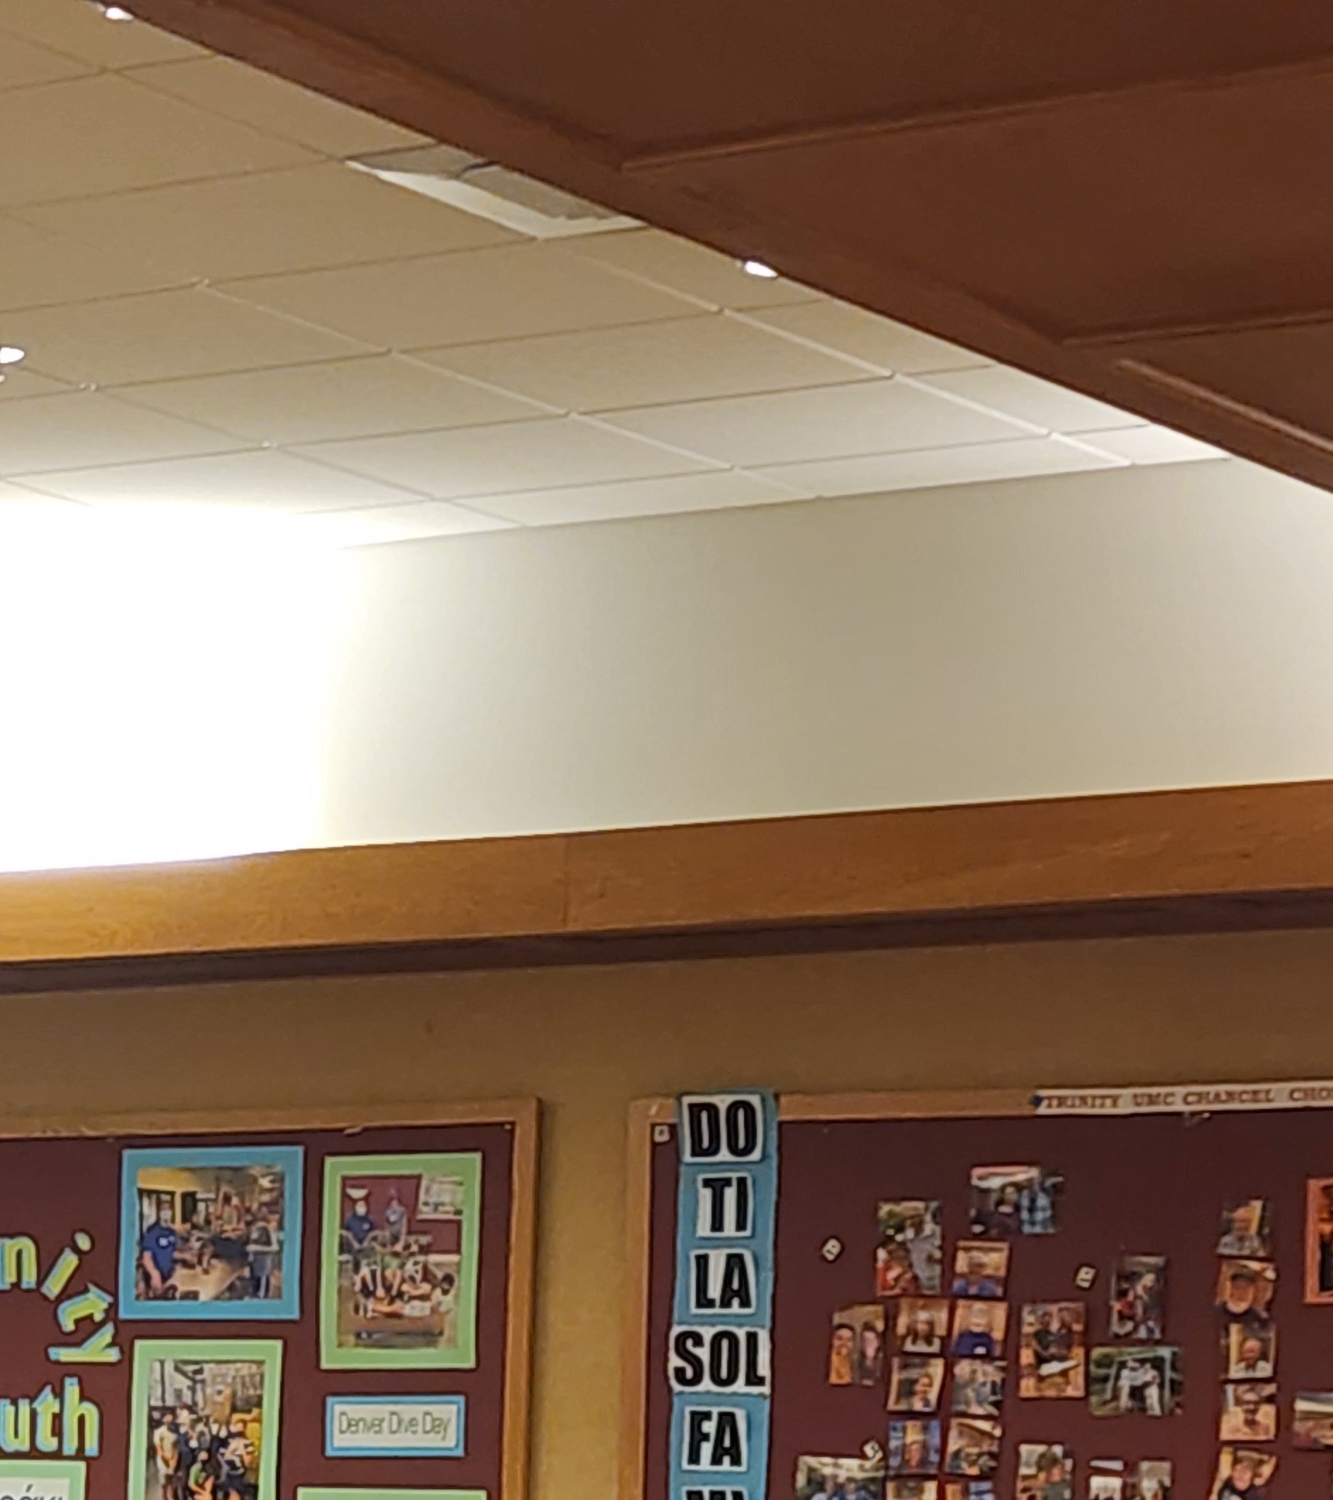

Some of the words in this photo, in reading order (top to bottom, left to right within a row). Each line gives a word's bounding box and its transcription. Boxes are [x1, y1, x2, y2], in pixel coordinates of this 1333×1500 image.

[1044, 1093, 1122, 1109] TRINITY
[1132, 1091, 1176, 1107] UMC
[1182, 1087, 1275, 1106] CHANCEL
[688, 1099, 760, 1159] DO
[701, 1176, 749, 1233] TI
[694, 1251, 753, 1311] LA
[673, 1329, 766, 1389] SOL
[338, 1411, 385, 1435] Denver
[388, 1411, 418, 1435] Dive
[422, 1411, 451, 1441] Day
[686, 1408, 744, 1467] FA
